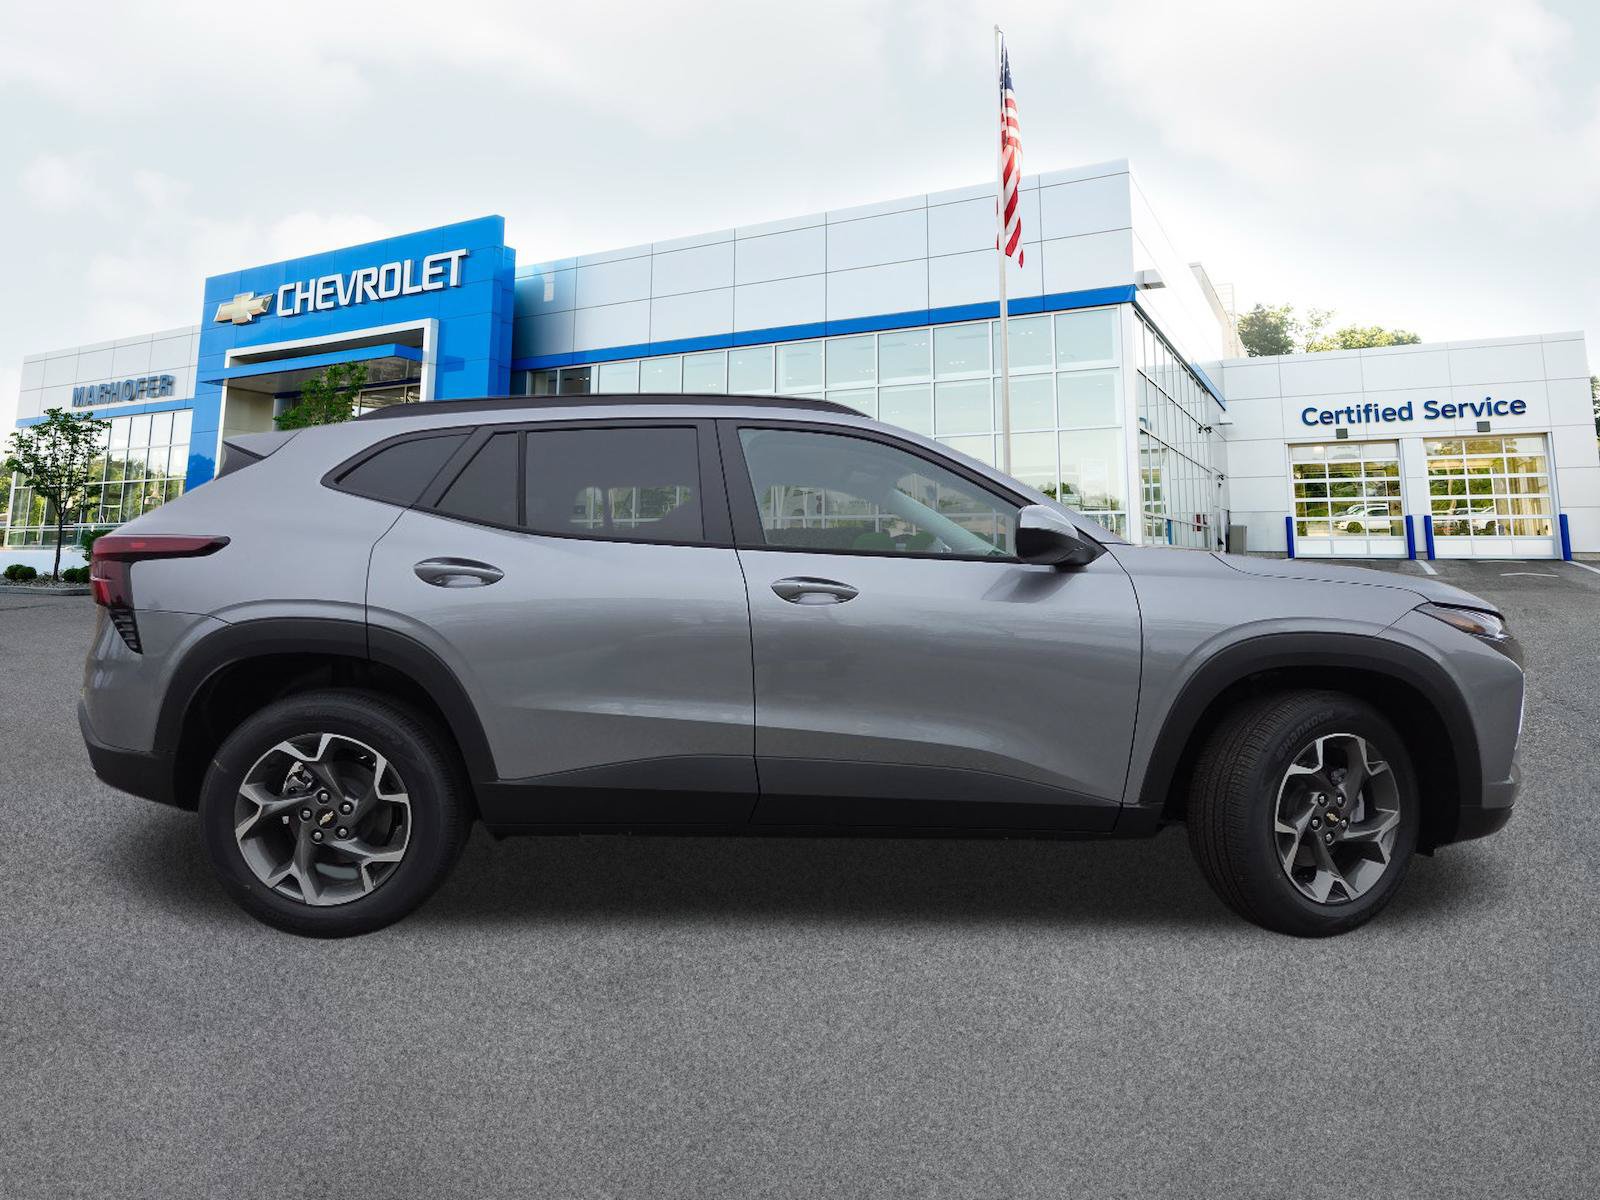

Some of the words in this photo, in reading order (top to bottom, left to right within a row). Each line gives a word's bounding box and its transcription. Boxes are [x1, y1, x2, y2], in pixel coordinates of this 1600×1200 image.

[277, 248, 469, 317] CHEVROLET
[72, 374, 175, 407] MARHOFER
[1301, 401, 1413, 426] Certified
[1424, 396, 1527, 420] Service
